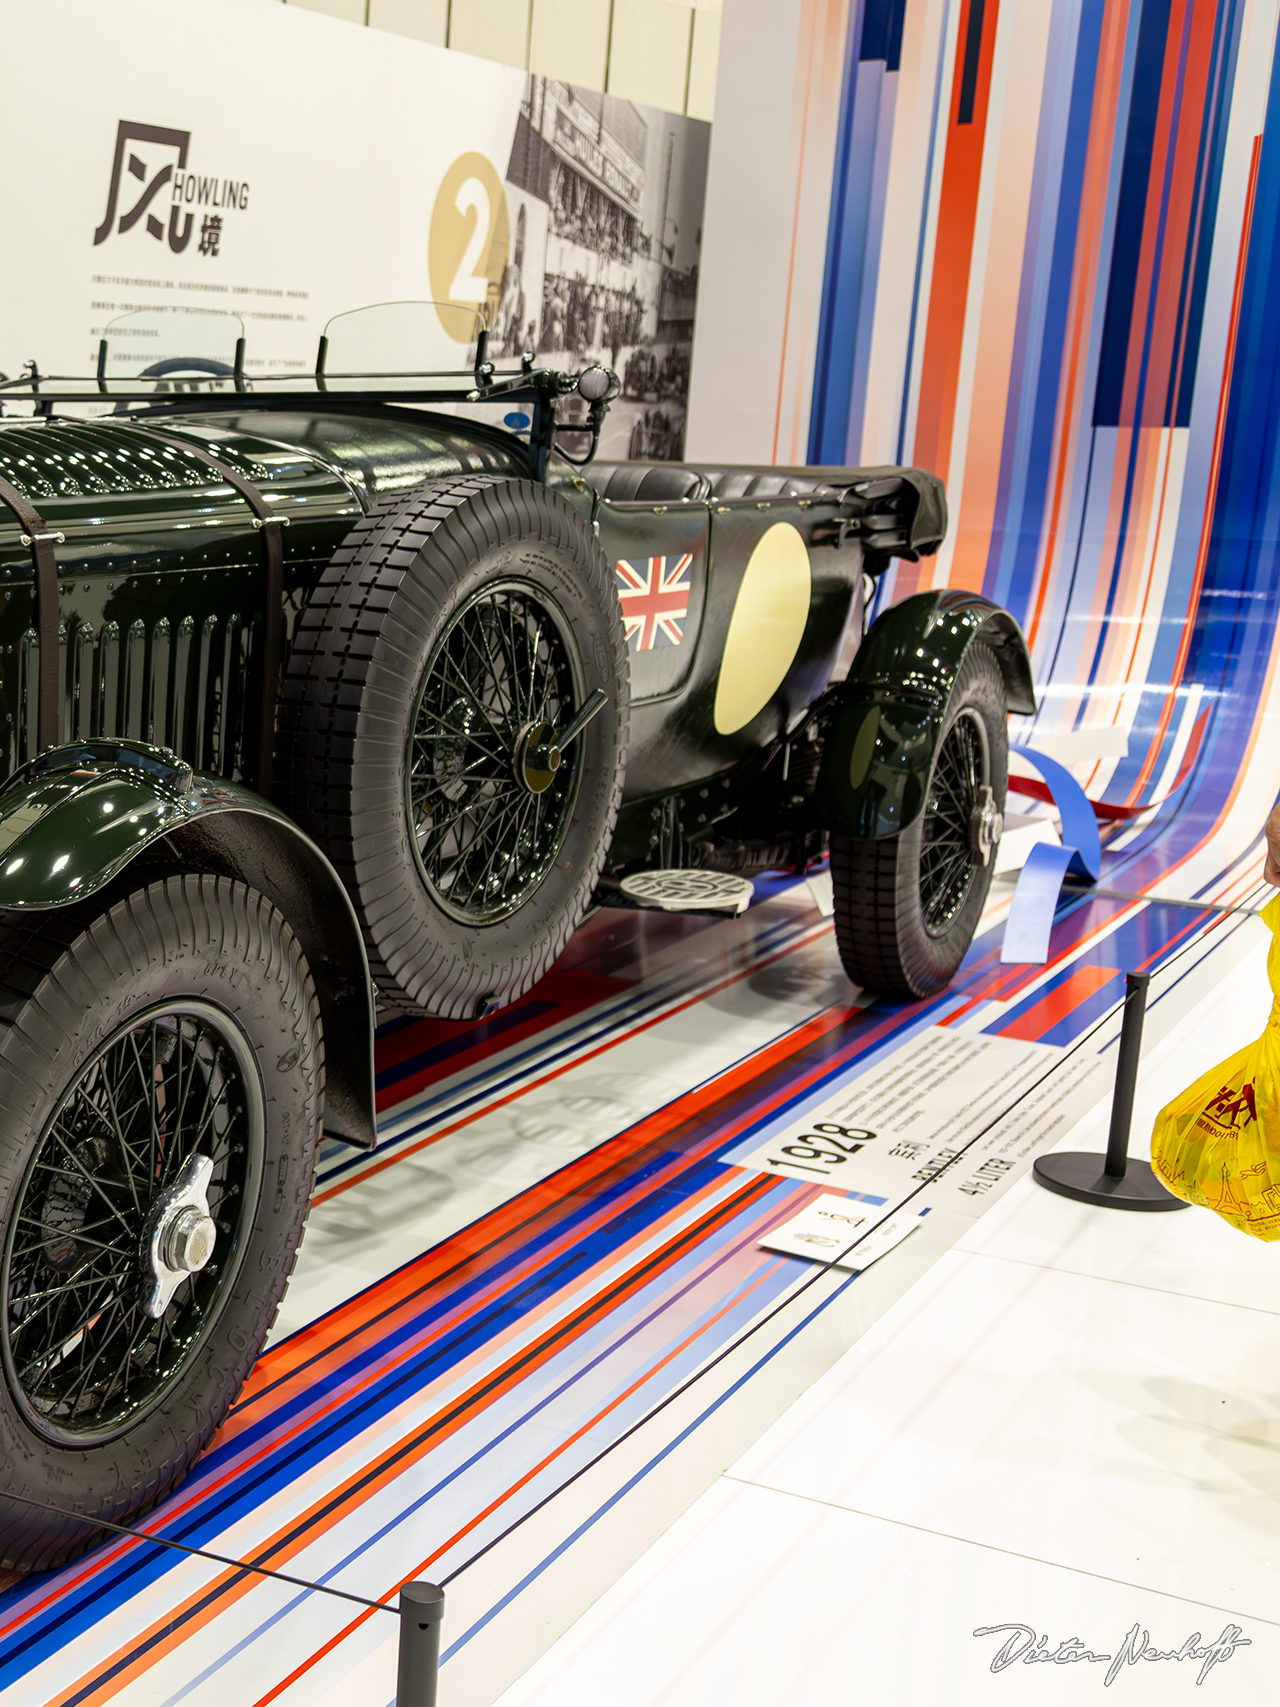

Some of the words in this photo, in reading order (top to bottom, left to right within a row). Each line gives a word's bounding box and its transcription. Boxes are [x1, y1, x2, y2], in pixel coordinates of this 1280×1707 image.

[172, 172, 250, 211] HOWLING
[449, 176, 490, 303] 2
[766, 1122, 878, 1175] 1928
[888, 1140, 931, 1160] 宾利
[911, 1147, 968, 1183] BENTLEY
[972, 1157, 1017, 1182] LITER
